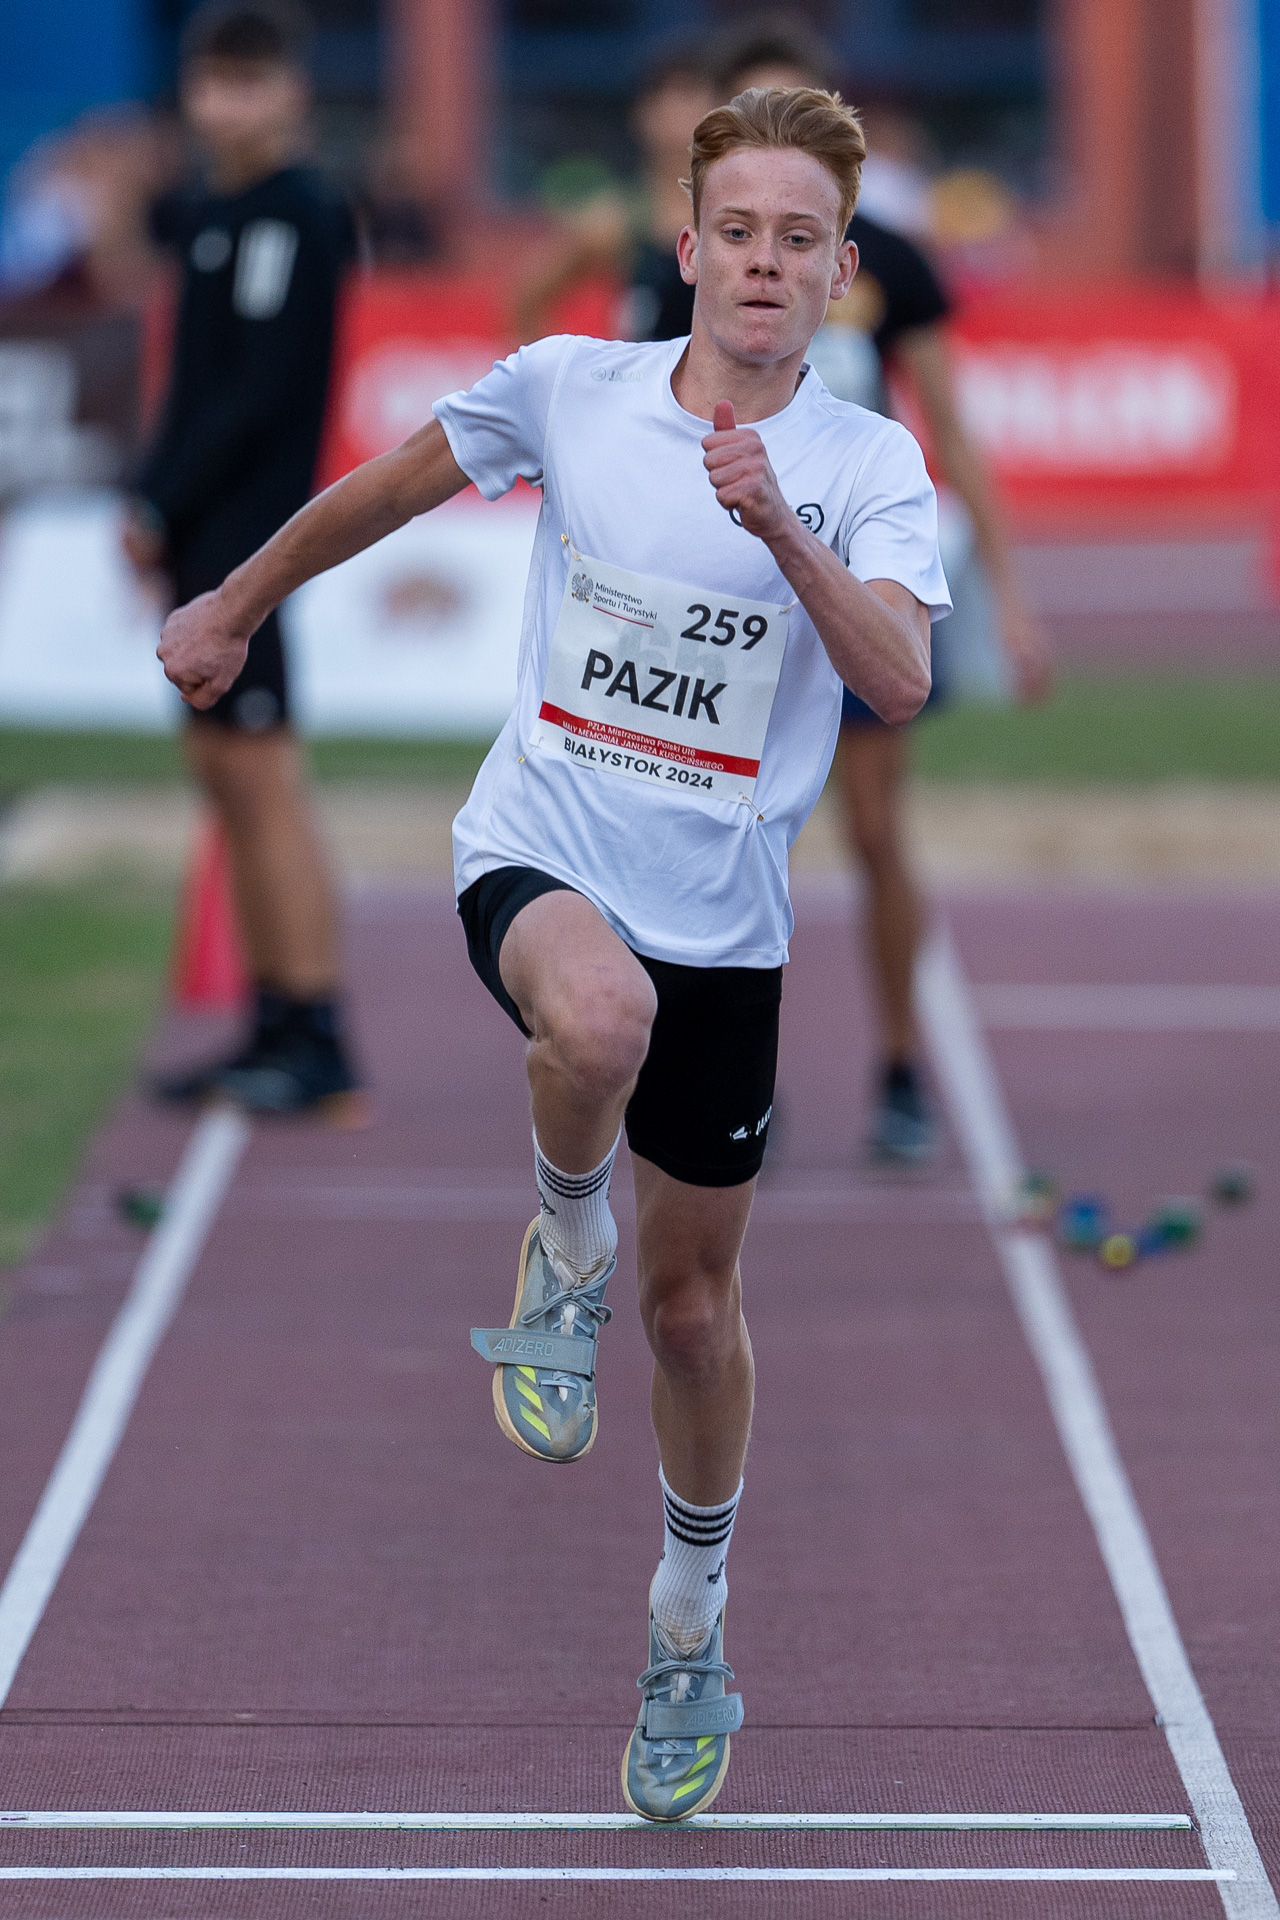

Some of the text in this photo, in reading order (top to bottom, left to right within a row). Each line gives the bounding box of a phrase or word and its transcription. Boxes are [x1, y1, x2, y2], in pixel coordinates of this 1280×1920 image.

[593, 592, 617, 608] Sportu
[622, 602, 658, 620] Turystyki
[595, 582, 643, 605] Ministerstwo
[680, 603, 768, 651] 259
[580, 648, 728, 725] PAZIK
[578, 728, 619, 745] MEMORIAŁ
[620, 739, 658, 755] JANUSZA
[658, 749, 724, 771] KUSOCIŃSKIEGO
[586, 721, 696, 757] PZLA Mistrzostwa Polski U16
[564, 736, 714, 790] BIAŁYSTOK 2024
[493, 1337, 555, 1357] ADIZERO
[685, 1706, 735, 1727] ADIZERO
